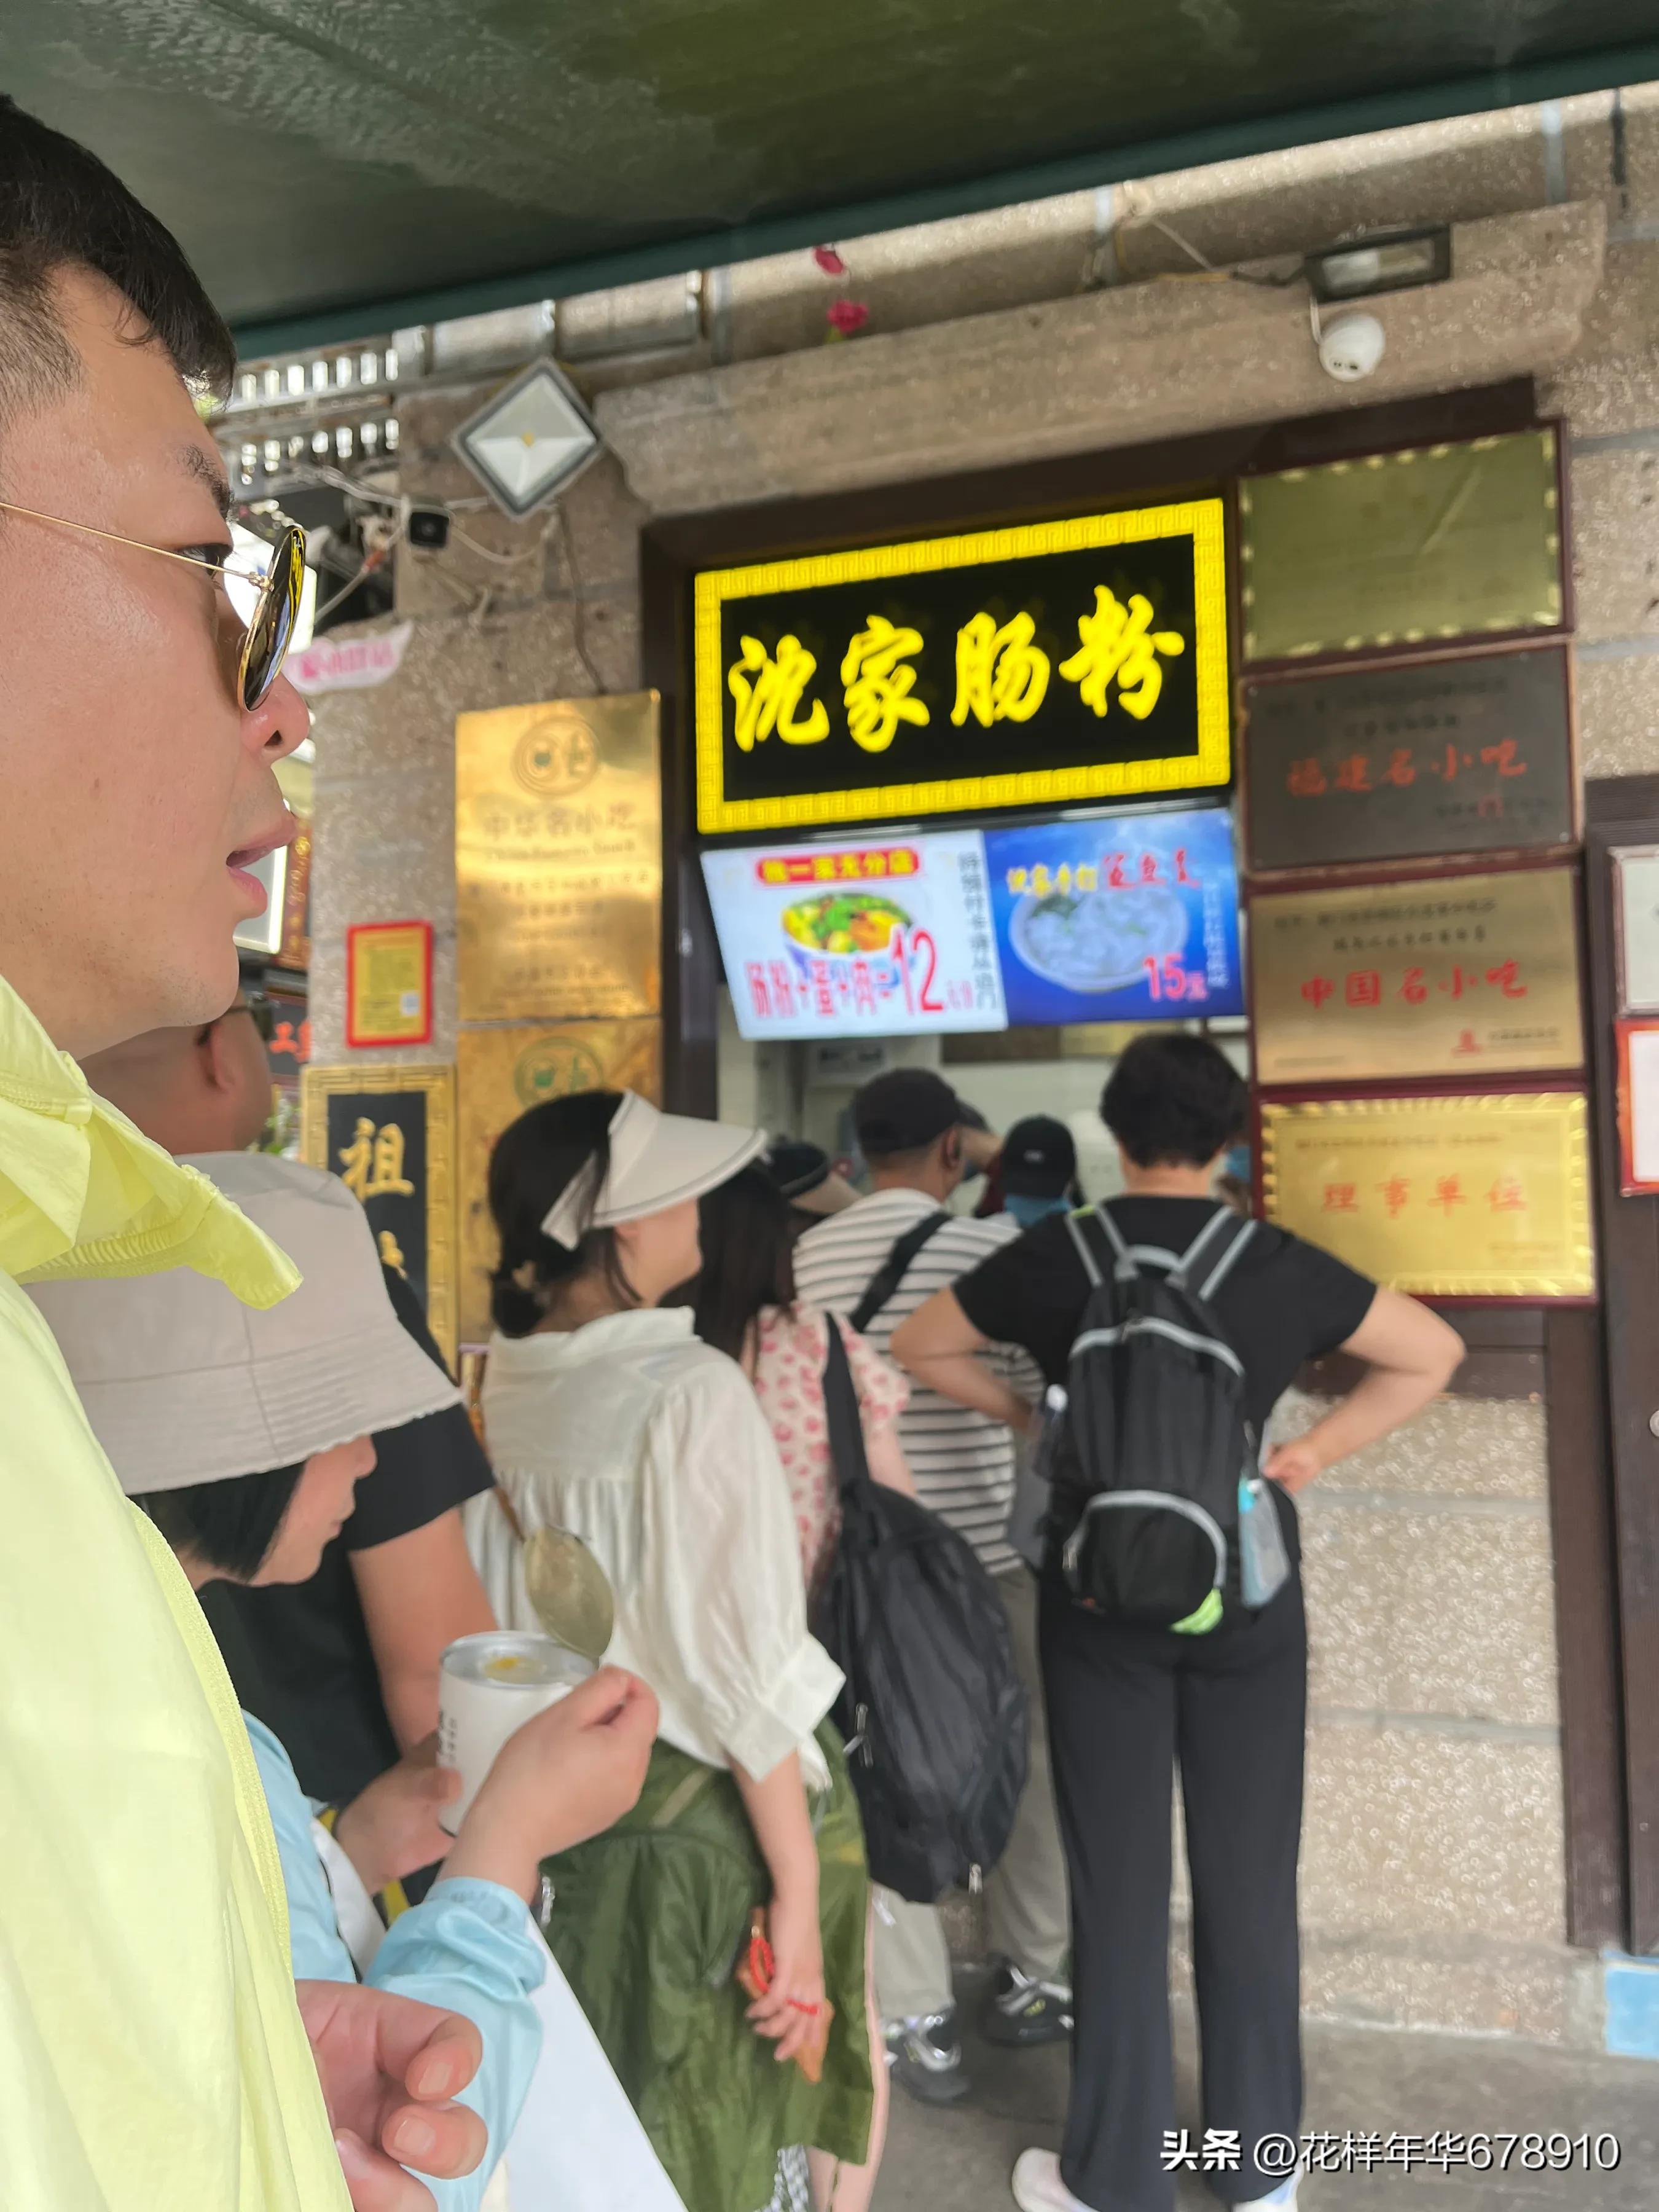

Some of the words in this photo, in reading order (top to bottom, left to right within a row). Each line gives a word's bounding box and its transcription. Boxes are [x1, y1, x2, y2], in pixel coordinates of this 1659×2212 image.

[728, 584, 1185, 752] 沈家肠粉
[1301, 959, 1527, 1010] 中国名小吃
[1320, 1172, 1526, 1218] 理事单位
